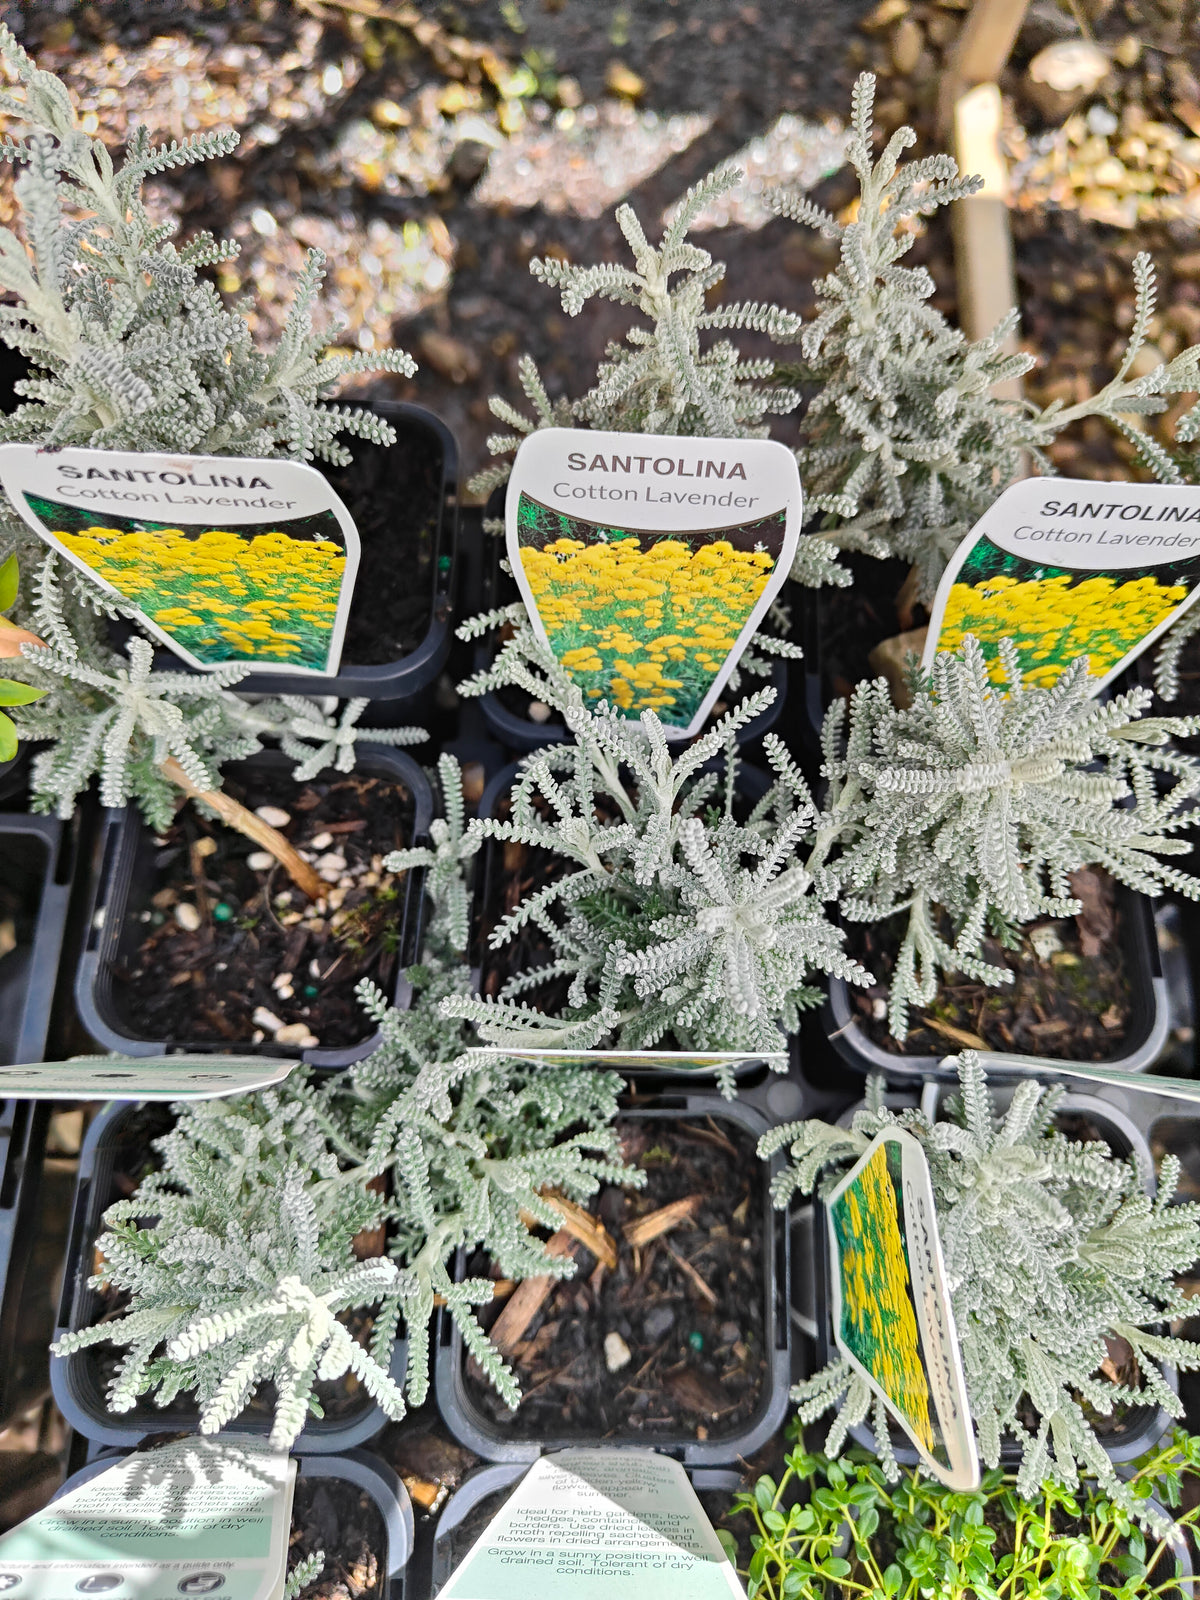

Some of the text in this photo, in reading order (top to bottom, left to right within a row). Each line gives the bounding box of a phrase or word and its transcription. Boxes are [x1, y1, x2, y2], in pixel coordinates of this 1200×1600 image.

[567, 452, 747, 480] SANTOLINA
[57, 465, 273, 490] SANTOLINA
[56, 485, 297, 510] Cotton Lavender
[553, 482, 760, 508] Cotton Lavender
[1040, 501, 1200, 522] SANTOLINA
[1014, 526, 1200, 548] Cotton Lavender
[917, 1196, 957, 1419] SANTOLINA
[606, 1510, 662, 1519] gardens,
[549, 1529, 604, 1538] repelling
[604, 1539, 703, 1548] arrangements.
[559, 1551, 601, 1560] sunny
[590, 1560, 648, 1568] Tolerant
[670, 1562, 694, 1570] dry
[557, 1567, 635, 1576] conditions.
